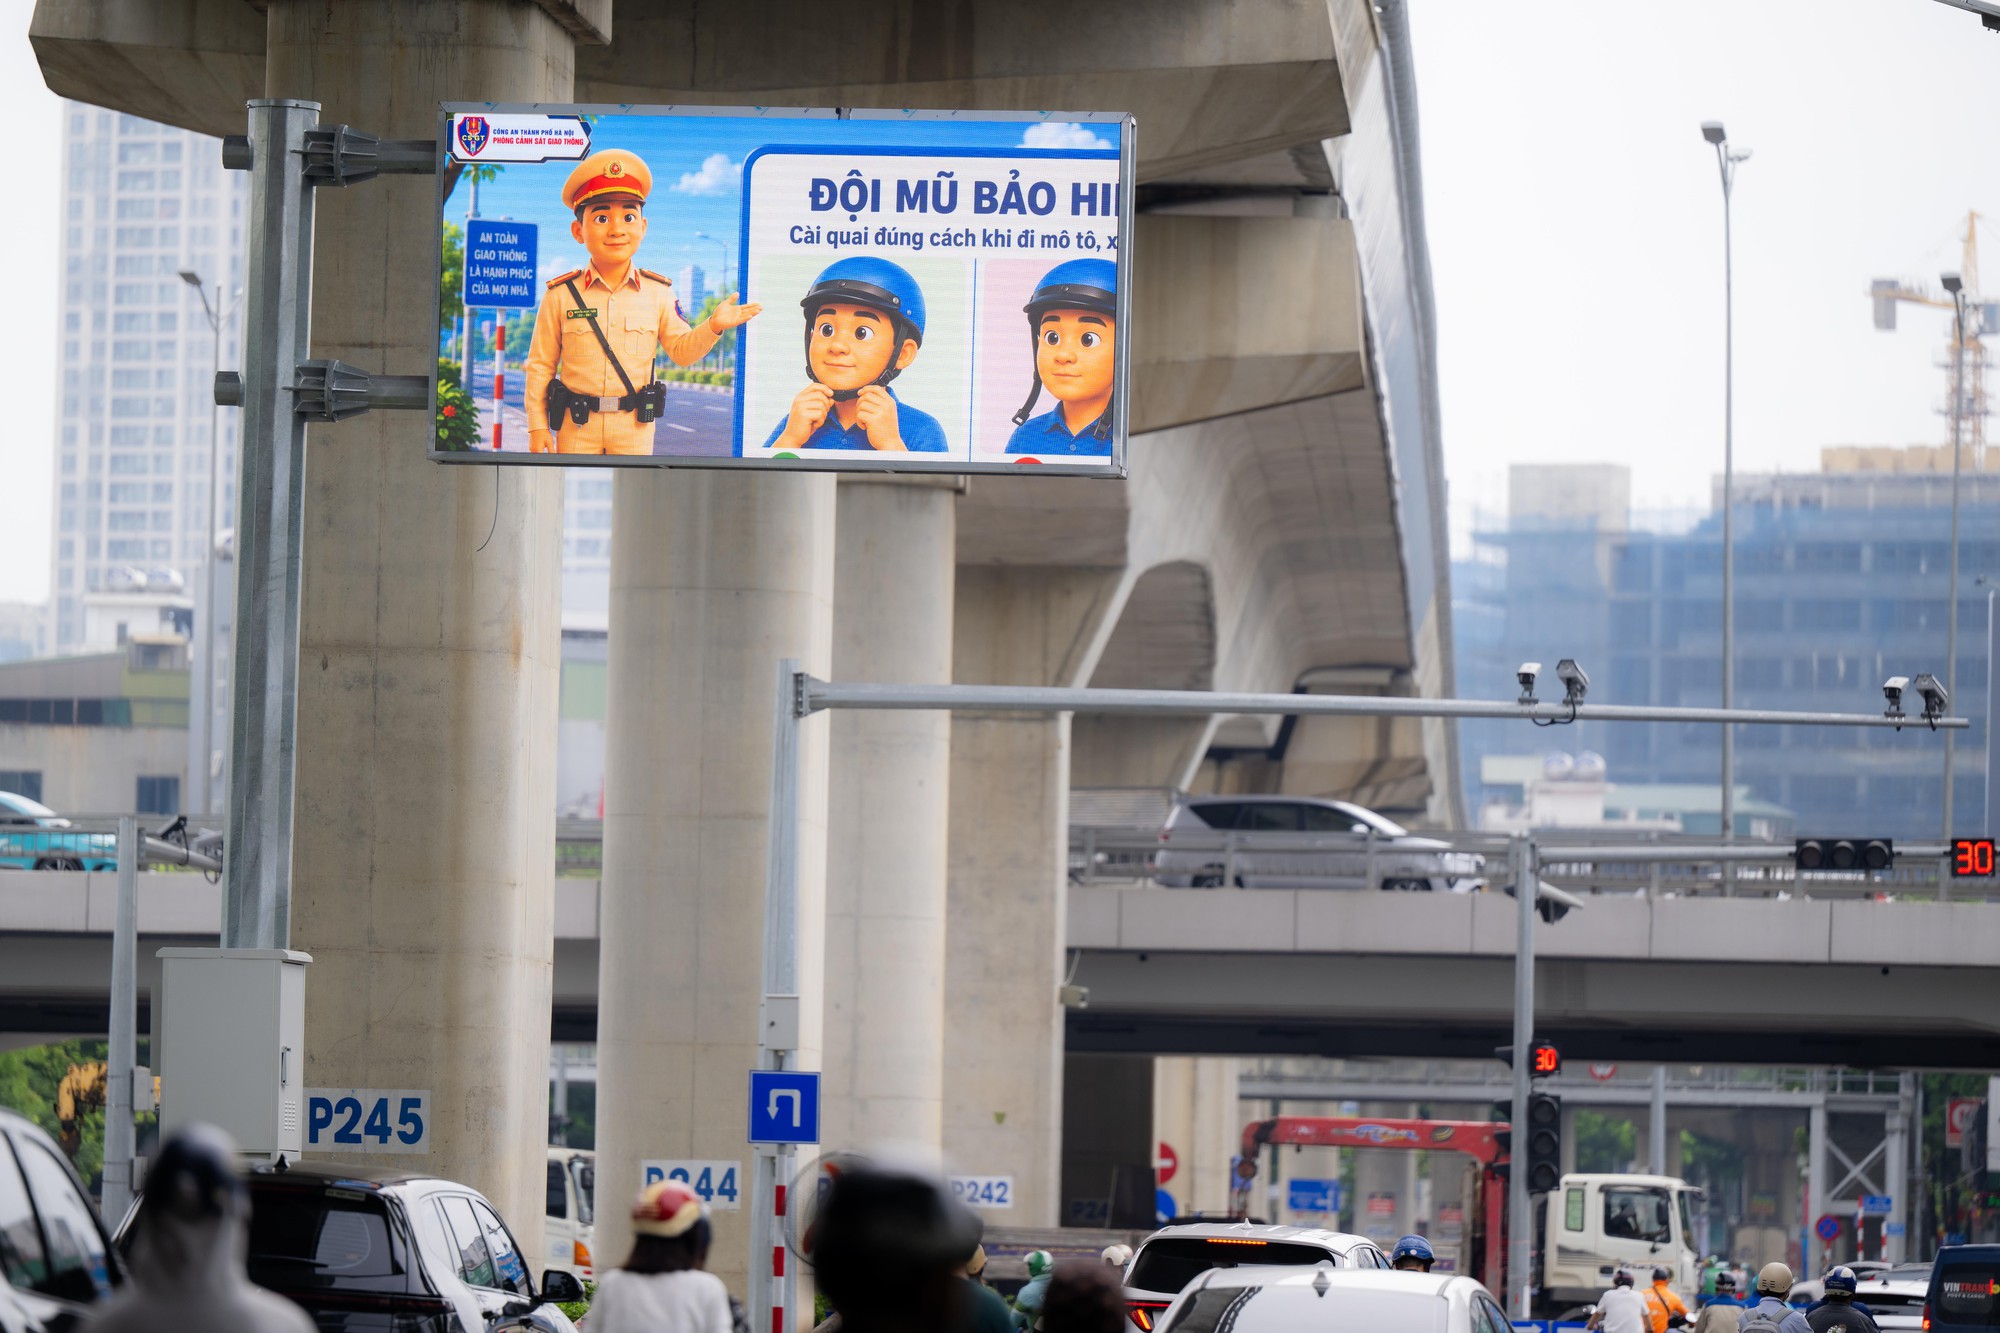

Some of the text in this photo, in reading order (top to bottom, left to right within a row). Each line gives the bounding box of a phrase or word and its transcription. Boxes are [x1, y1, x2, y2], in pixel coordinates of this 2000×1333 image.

[492, 136, 514, 144] PHÒNG
[515, 135, 533, 145] CẢNH
[534, 136, 546, 145] SÁT
[563, 137, 584, 146] THÔNG
[520, 128, 540, 136] THÀNH
[554, 128, 562, 136] HÀ
[808, 169, 1119, 222] ĐỘI MŨ BẢO HI
[479, 231, 518, 245] AN TOÀN
[789, 225, 821, 244] Cài
[826, 226, 869, 249] quai
[874, 226, 924, 251] đúng
[929, 227, 976, 247] cách
[982, 228, 1011, 248] khi
[1017, 229, 1035, 248] đi
[1040, 229, 1071, 249] mô
[1076, 230, 1101, 252] tô,
[474, 248, 528, 262] GIAO THÔNG
[469, 264, 533, 280] LÀ HẠNH PHÚC
[471, 281, 529, 298] CỦA MỌI NHÀ
[1956, 841, 1993, 874] 30
[1535, 1047, 1557, 1071] 30
[308, 1096, 424, 1145] P245
[951, 1180, 1009, 1203] P242
